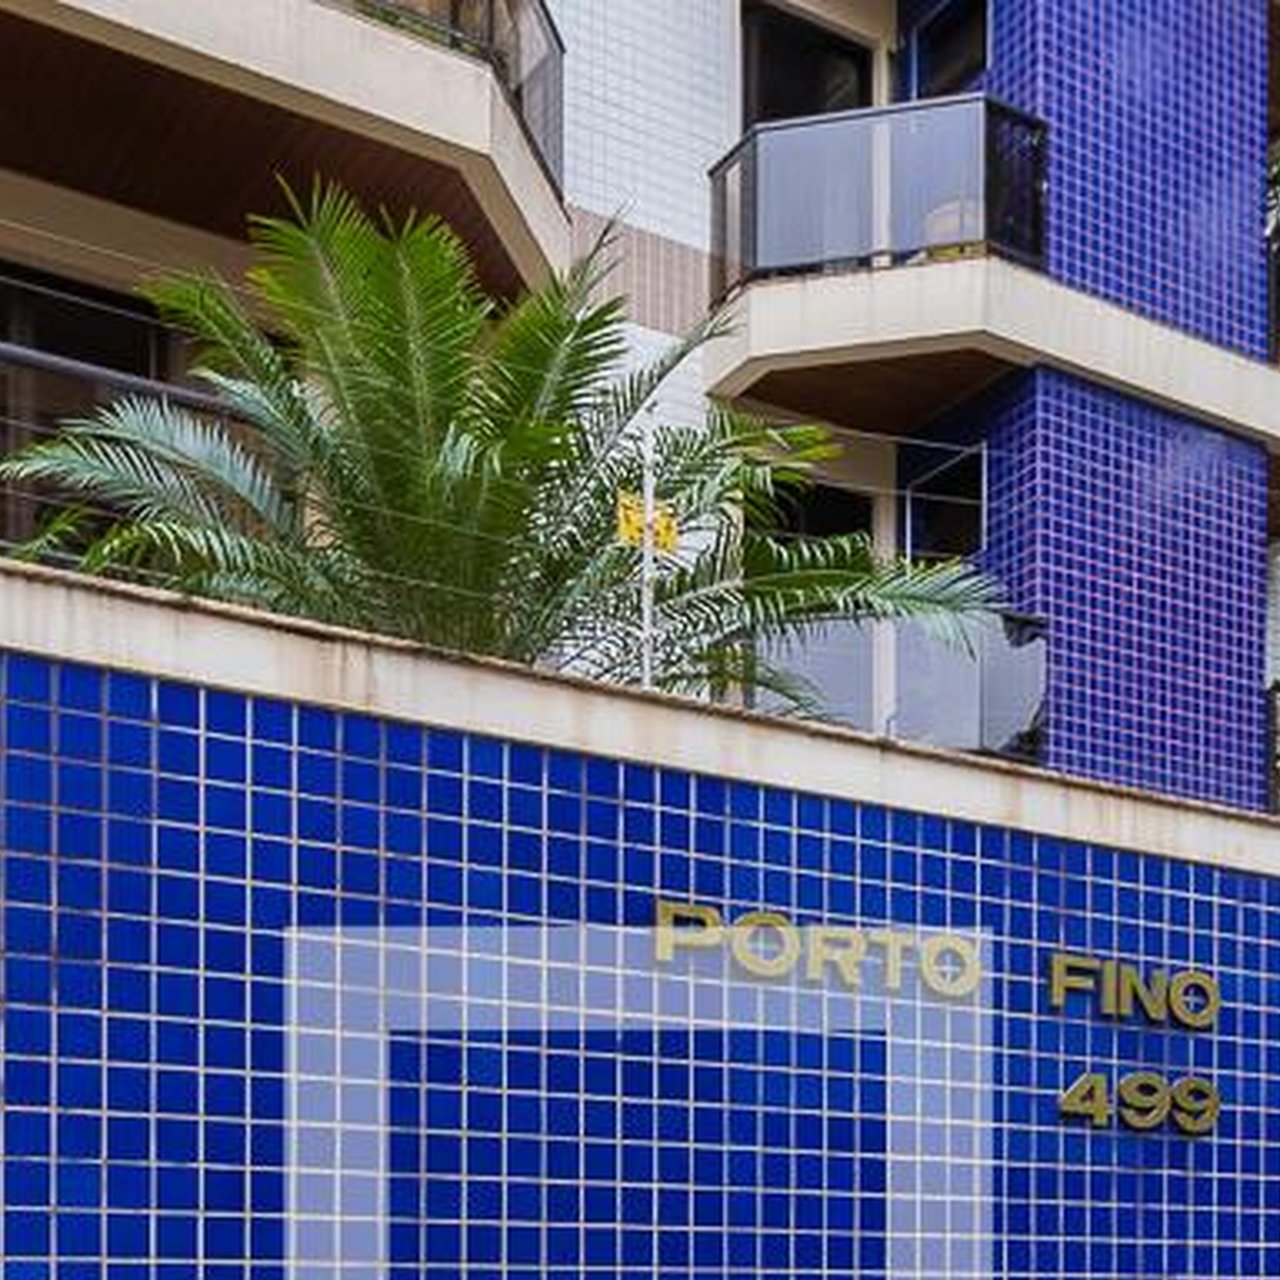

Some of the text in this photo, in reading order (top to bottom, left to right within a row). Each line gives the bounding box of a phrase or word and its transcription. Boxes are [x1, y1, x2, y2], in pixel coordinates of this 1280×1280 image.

[654, 898, 1221, 1029] PORTO FINO
[1058, 1073, 1221, 1135] 499
